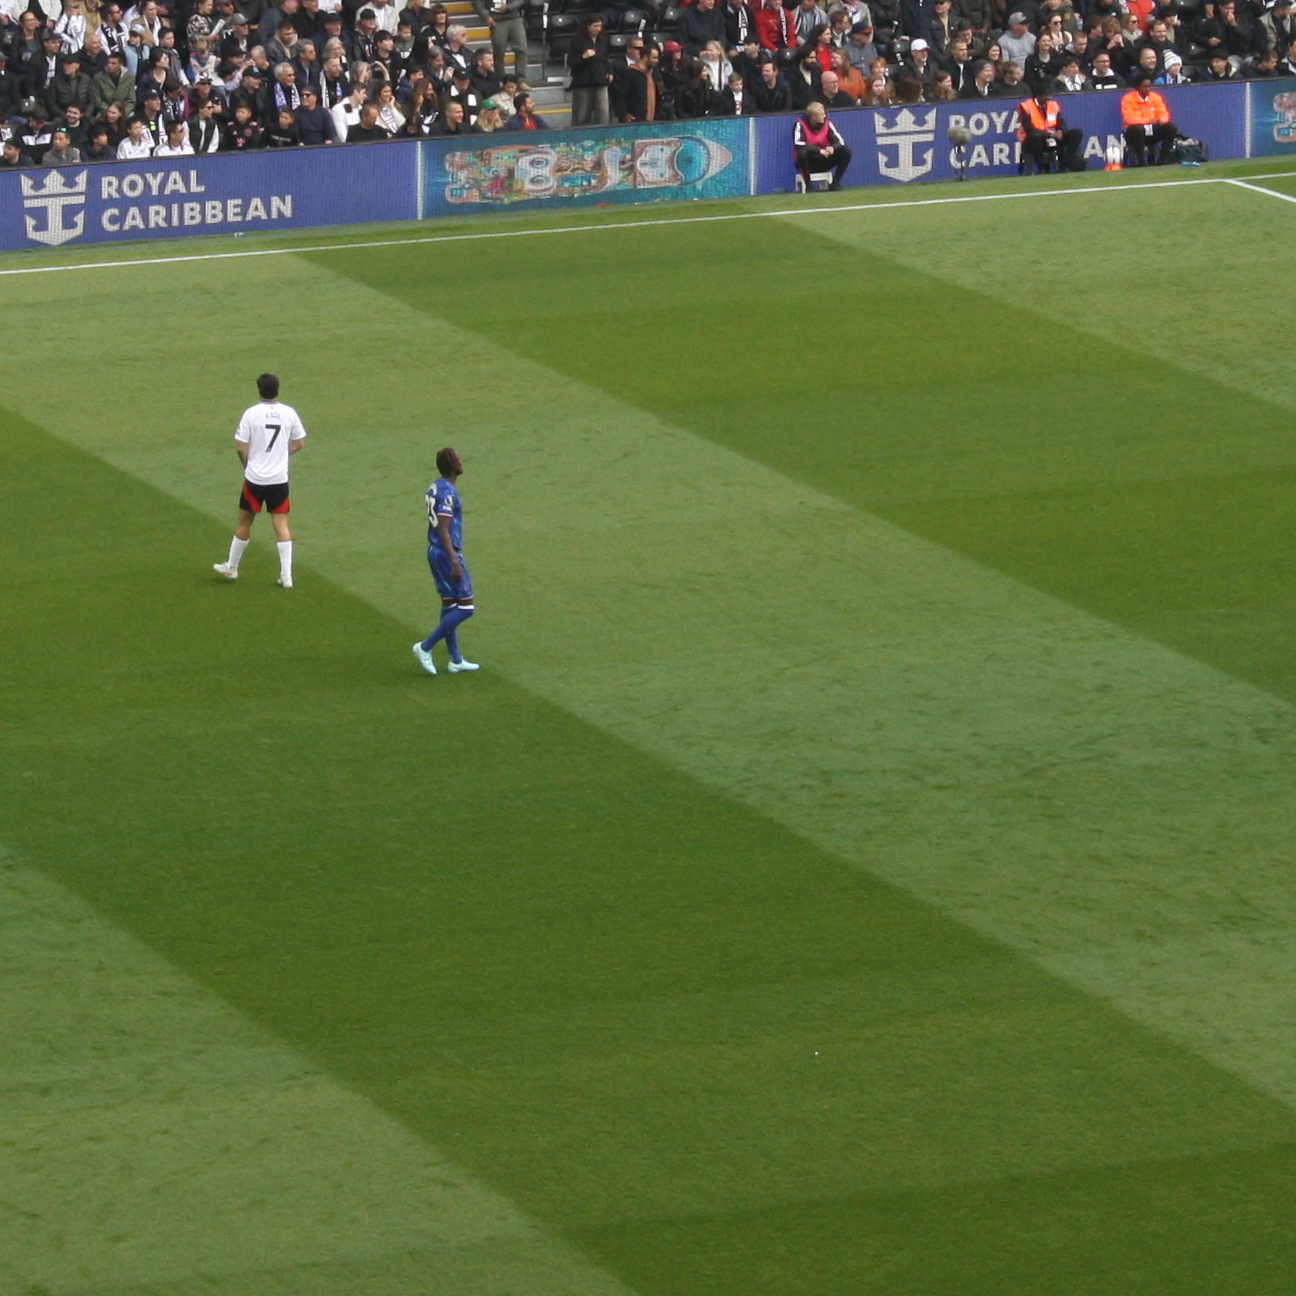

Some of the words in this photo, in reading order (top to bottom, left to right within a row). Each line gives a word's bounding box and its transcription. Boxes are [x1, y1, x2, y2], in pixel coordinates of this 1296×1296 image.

[101, 170, 205, 200] ROYAL
[101, 194, 293, 232] CARIBBEAN
[264, 424, 281, 453] 7
